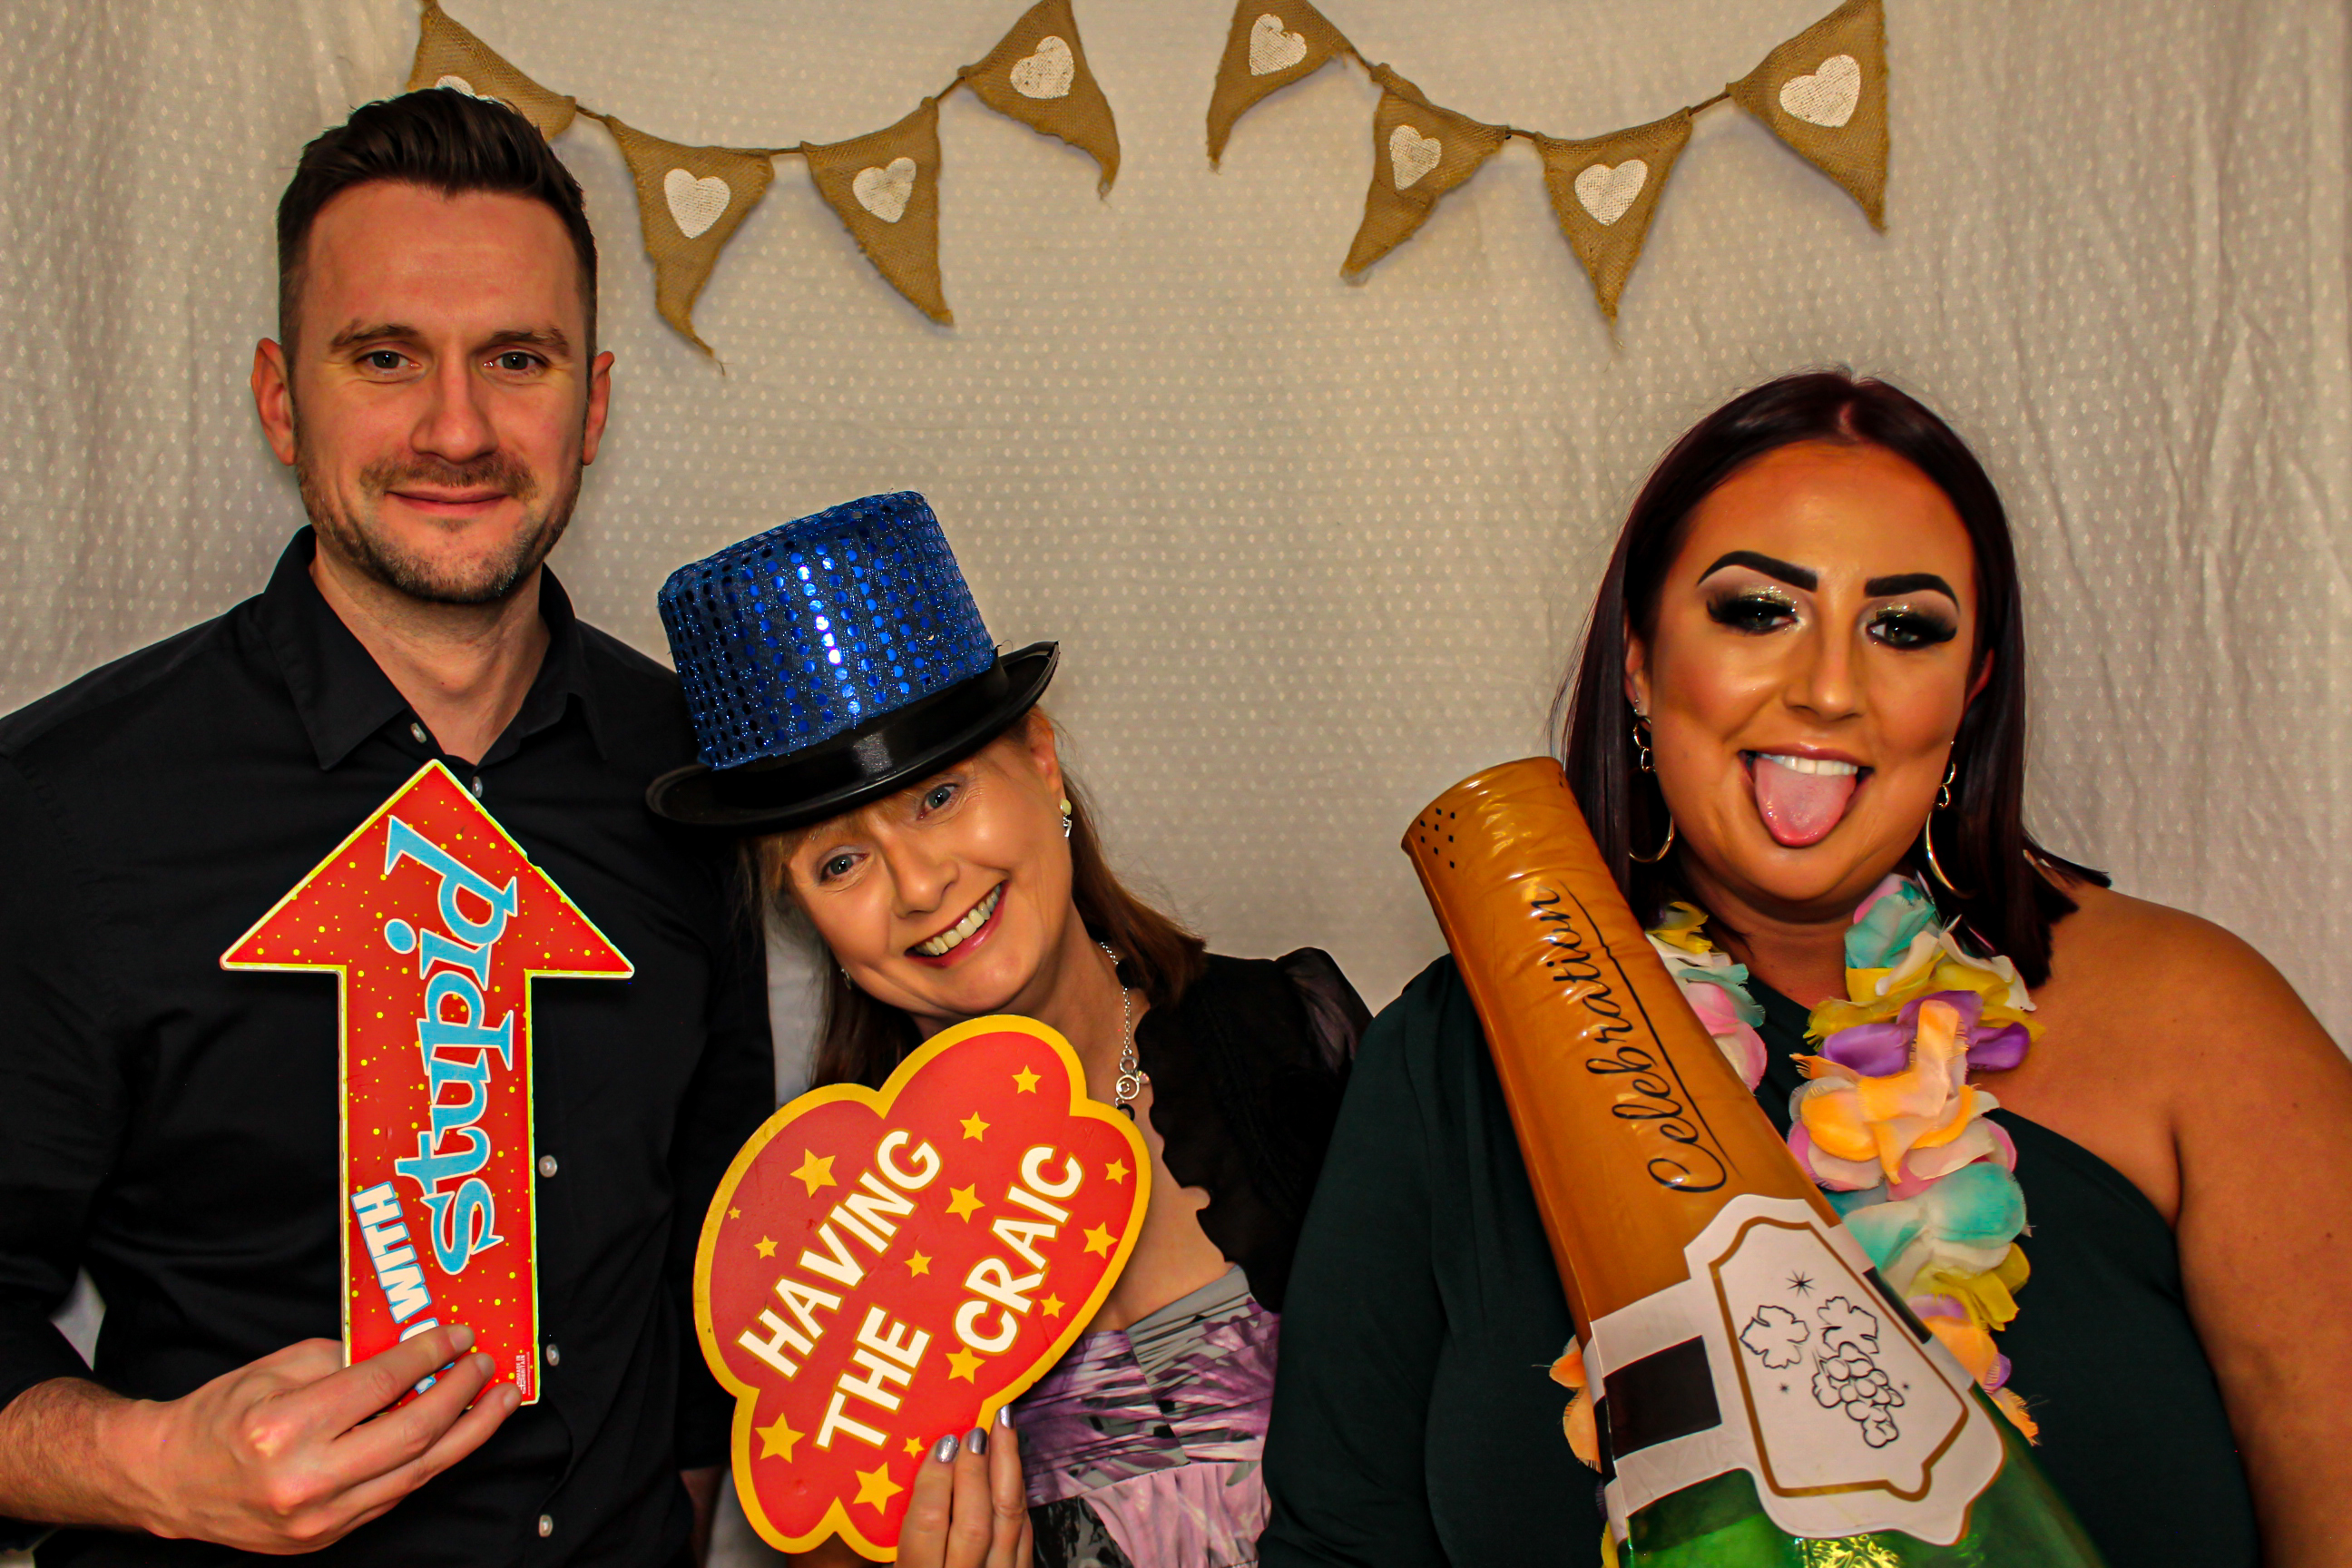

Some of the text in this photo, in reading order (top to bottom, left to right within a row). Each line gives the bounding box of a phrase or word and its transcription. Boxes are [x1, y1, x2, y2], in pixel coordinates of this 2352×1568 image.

[385, 815, 518, 1275] stupid
[1530, 885, 1727, 1193] Celebration
[350, 1181, 432, 1324] WITH
[735, 1129, 943, 1378] HAVING
[815, 1145, 1084, 1449] THE CRAIC
